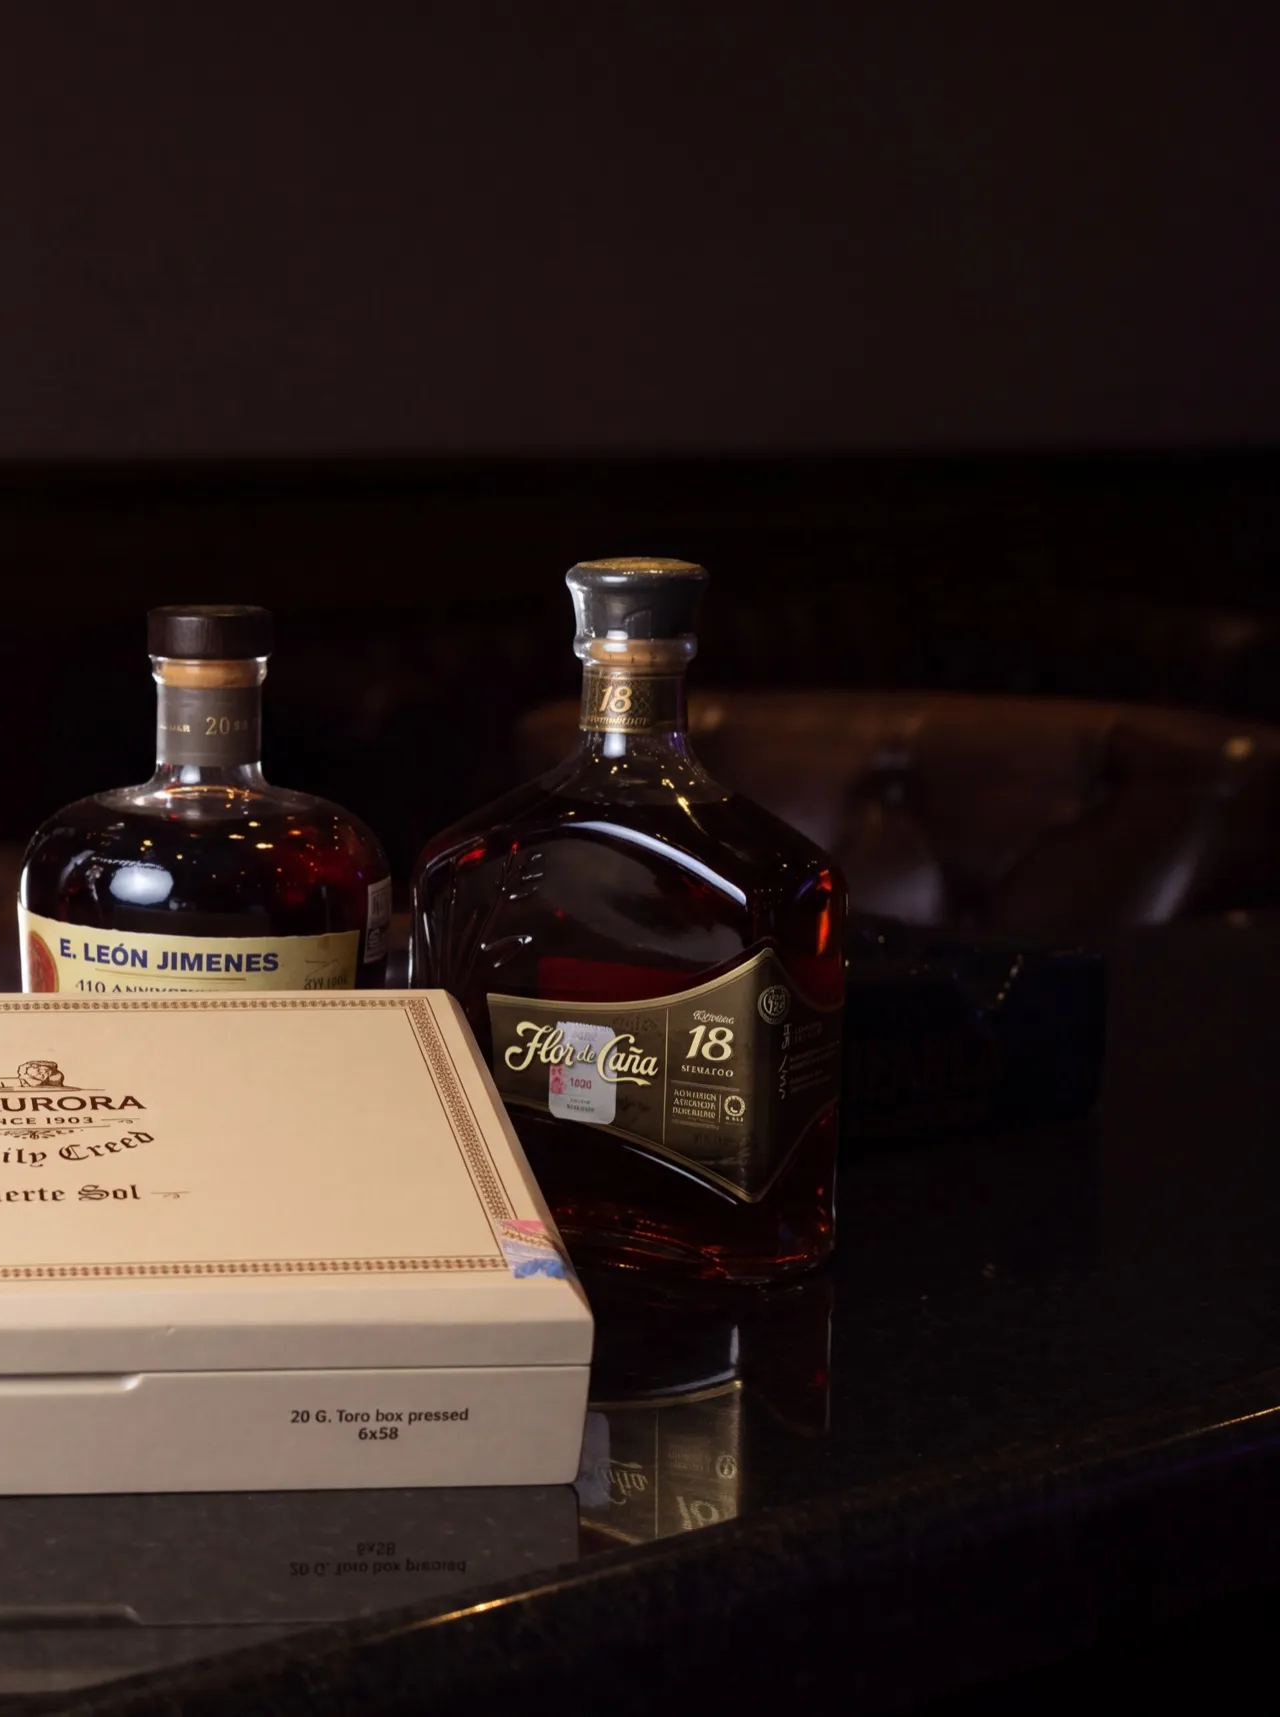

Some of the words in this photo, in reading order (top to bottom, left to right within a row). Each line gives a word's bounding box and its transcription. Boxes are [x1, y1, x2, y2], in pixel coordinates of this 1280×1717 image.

[599, 686, 632, 713] 18
[205, 716, 230, 735] 20
[60, 938, 77, 960] E.
[84, 943, 148, 968] LEÓN
[157, 952, 280, 973] JIMENES
[505, 1021, 575, 1071] Flor
[576, 1048, 595, 1064] de
[595, 1033, 659, 1087] Caña
[686, 1024, 734, 1061] 18
[46, 1116, 94, 1124] 1903
[58, 1130, 155, 1161] Creed
[78, 1184, 142, 1202] Sol
[290, 1409, 310, 1424] 20
[315, 1409, 332, 1424] G.
[336, 1409, 370, 1423] Toro
[376, 1408, 404, 1422] box
[408, 1408, 469, 1425] pressed
[358, 1427, 399, 1441] 6x58
